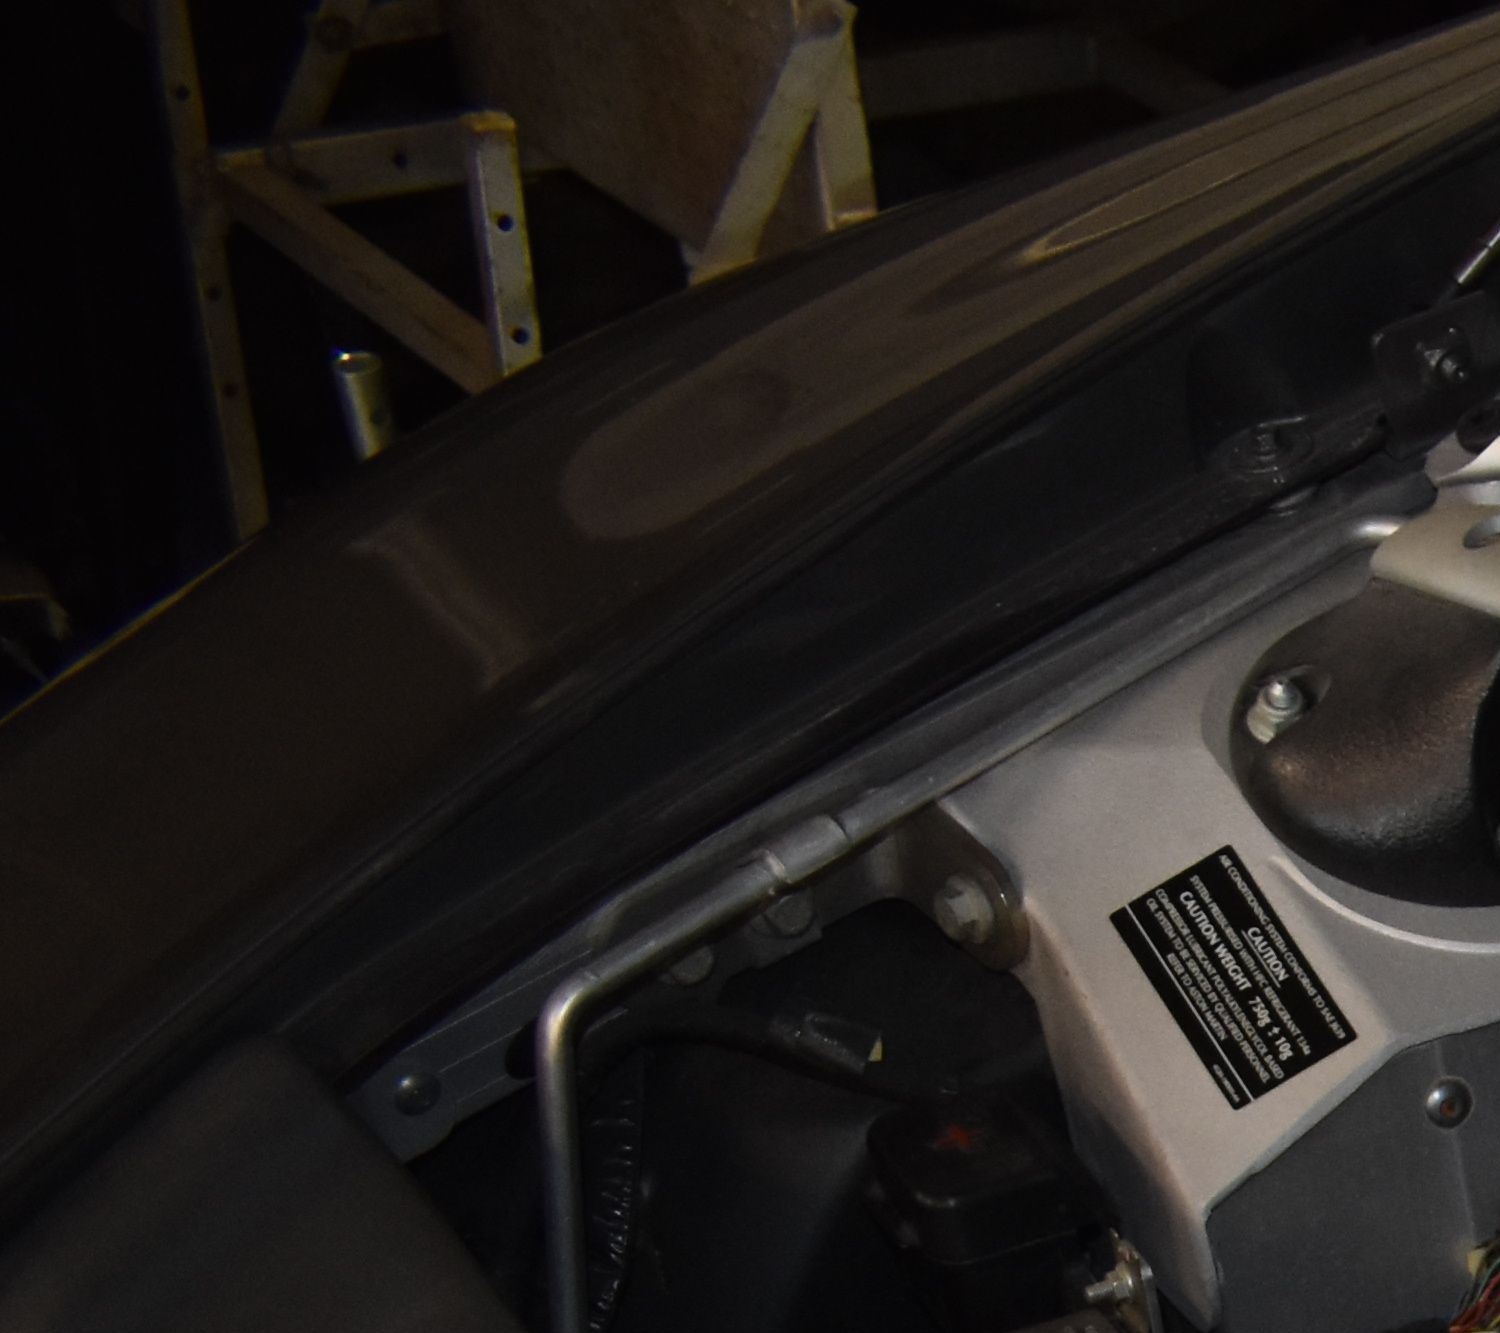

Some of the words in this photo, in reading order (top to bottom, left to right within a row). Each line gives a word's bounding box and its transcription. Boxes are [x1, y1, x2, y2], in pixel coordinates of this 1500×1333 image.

[1153, 910, 1176, 939] SYSTEM
[1172, 936, 1184, 950] TO
[1185, 957, 1212, 993] SERVICED
[1213, 1001, 1244, 1041] QUALIFIED
[1238, 1039, 1270, 1083] PERSONNEL
[1154, 888, 1190, 936] COMPRESSOR
[1184, 933, 1217, 975] LUBRICANT
[1263, 1053, 1284, 1079] BASED
[1166, 952, 1185, 975] REFER
[1180, 972, 1192, 986] TO
[1188, 985, 1208, 1012] ASTON
[1204, 1010, 1227, 1041] MARTIN
[1179, 890, 1221, 945] CAUTION
[1213, 942, 1252, 990] WEIGHT
[1247, 995, 1271, 1027] 750g
[1274, 1035, 1293, 1061] 10g
[1189, 874, 1212, 904] SYSTEM
[1207, 901, 1243, 950] PRESSURISED
[1238, 948, 1257, 971] WITH
[1263, 985, 1301, 1036] REFRIGERANT
[1227, 866, 1270, 925] CONDITIONING
[1264, 922, 1288, 953] SYSTEM
[1312, 994, 1325, 1008] TO
[1246, 926, 1289, 981] CAUTION
